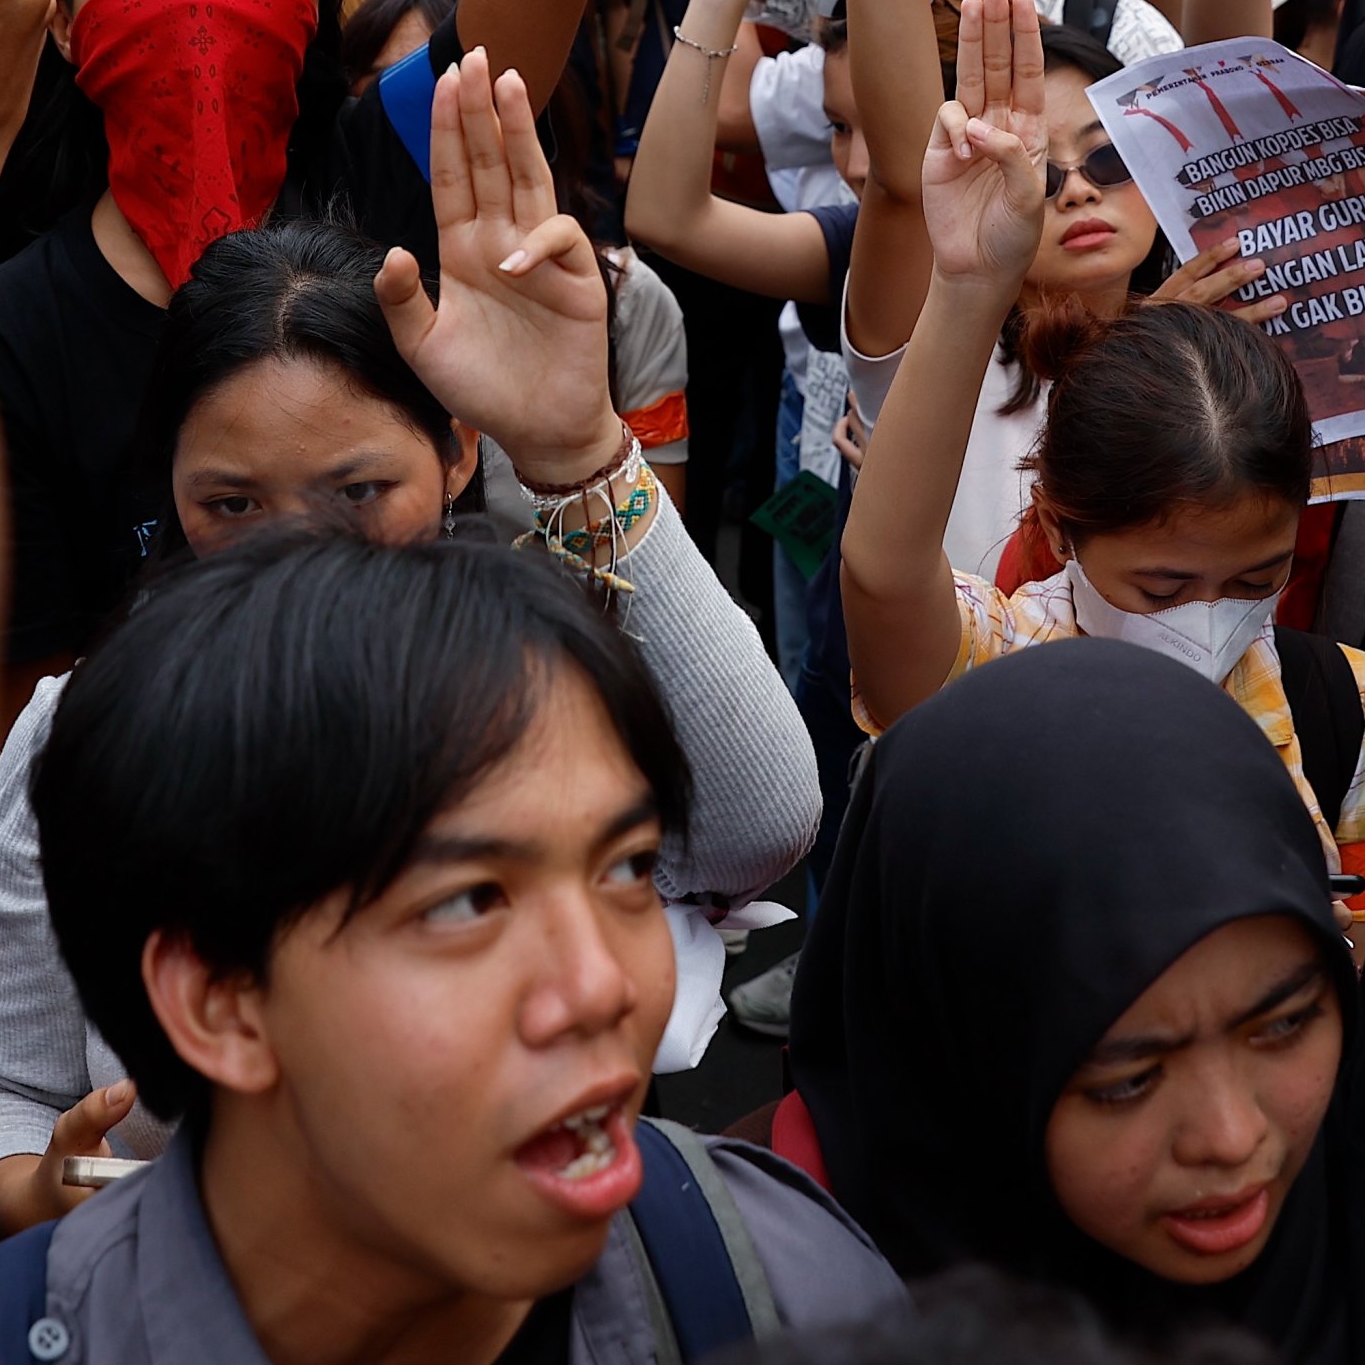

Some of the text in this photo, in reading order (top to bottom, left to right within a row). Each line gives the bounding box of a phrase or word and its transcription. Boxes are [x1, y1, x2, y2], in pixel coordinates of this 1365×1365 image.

[1210, 65, 1244, 78] PRABOWO
[1185, 116, 1361, 183] BANGUN KOPDES BISA
[1196, 184, 1248, 217] BIKIN
[1244, 166, 1303, 202] DAPUR
[1303, 155, 1342, 182] MBG
[1238, 211, 1317, 257] BAYAR
[1291, 292, 1344, 329] GAK
